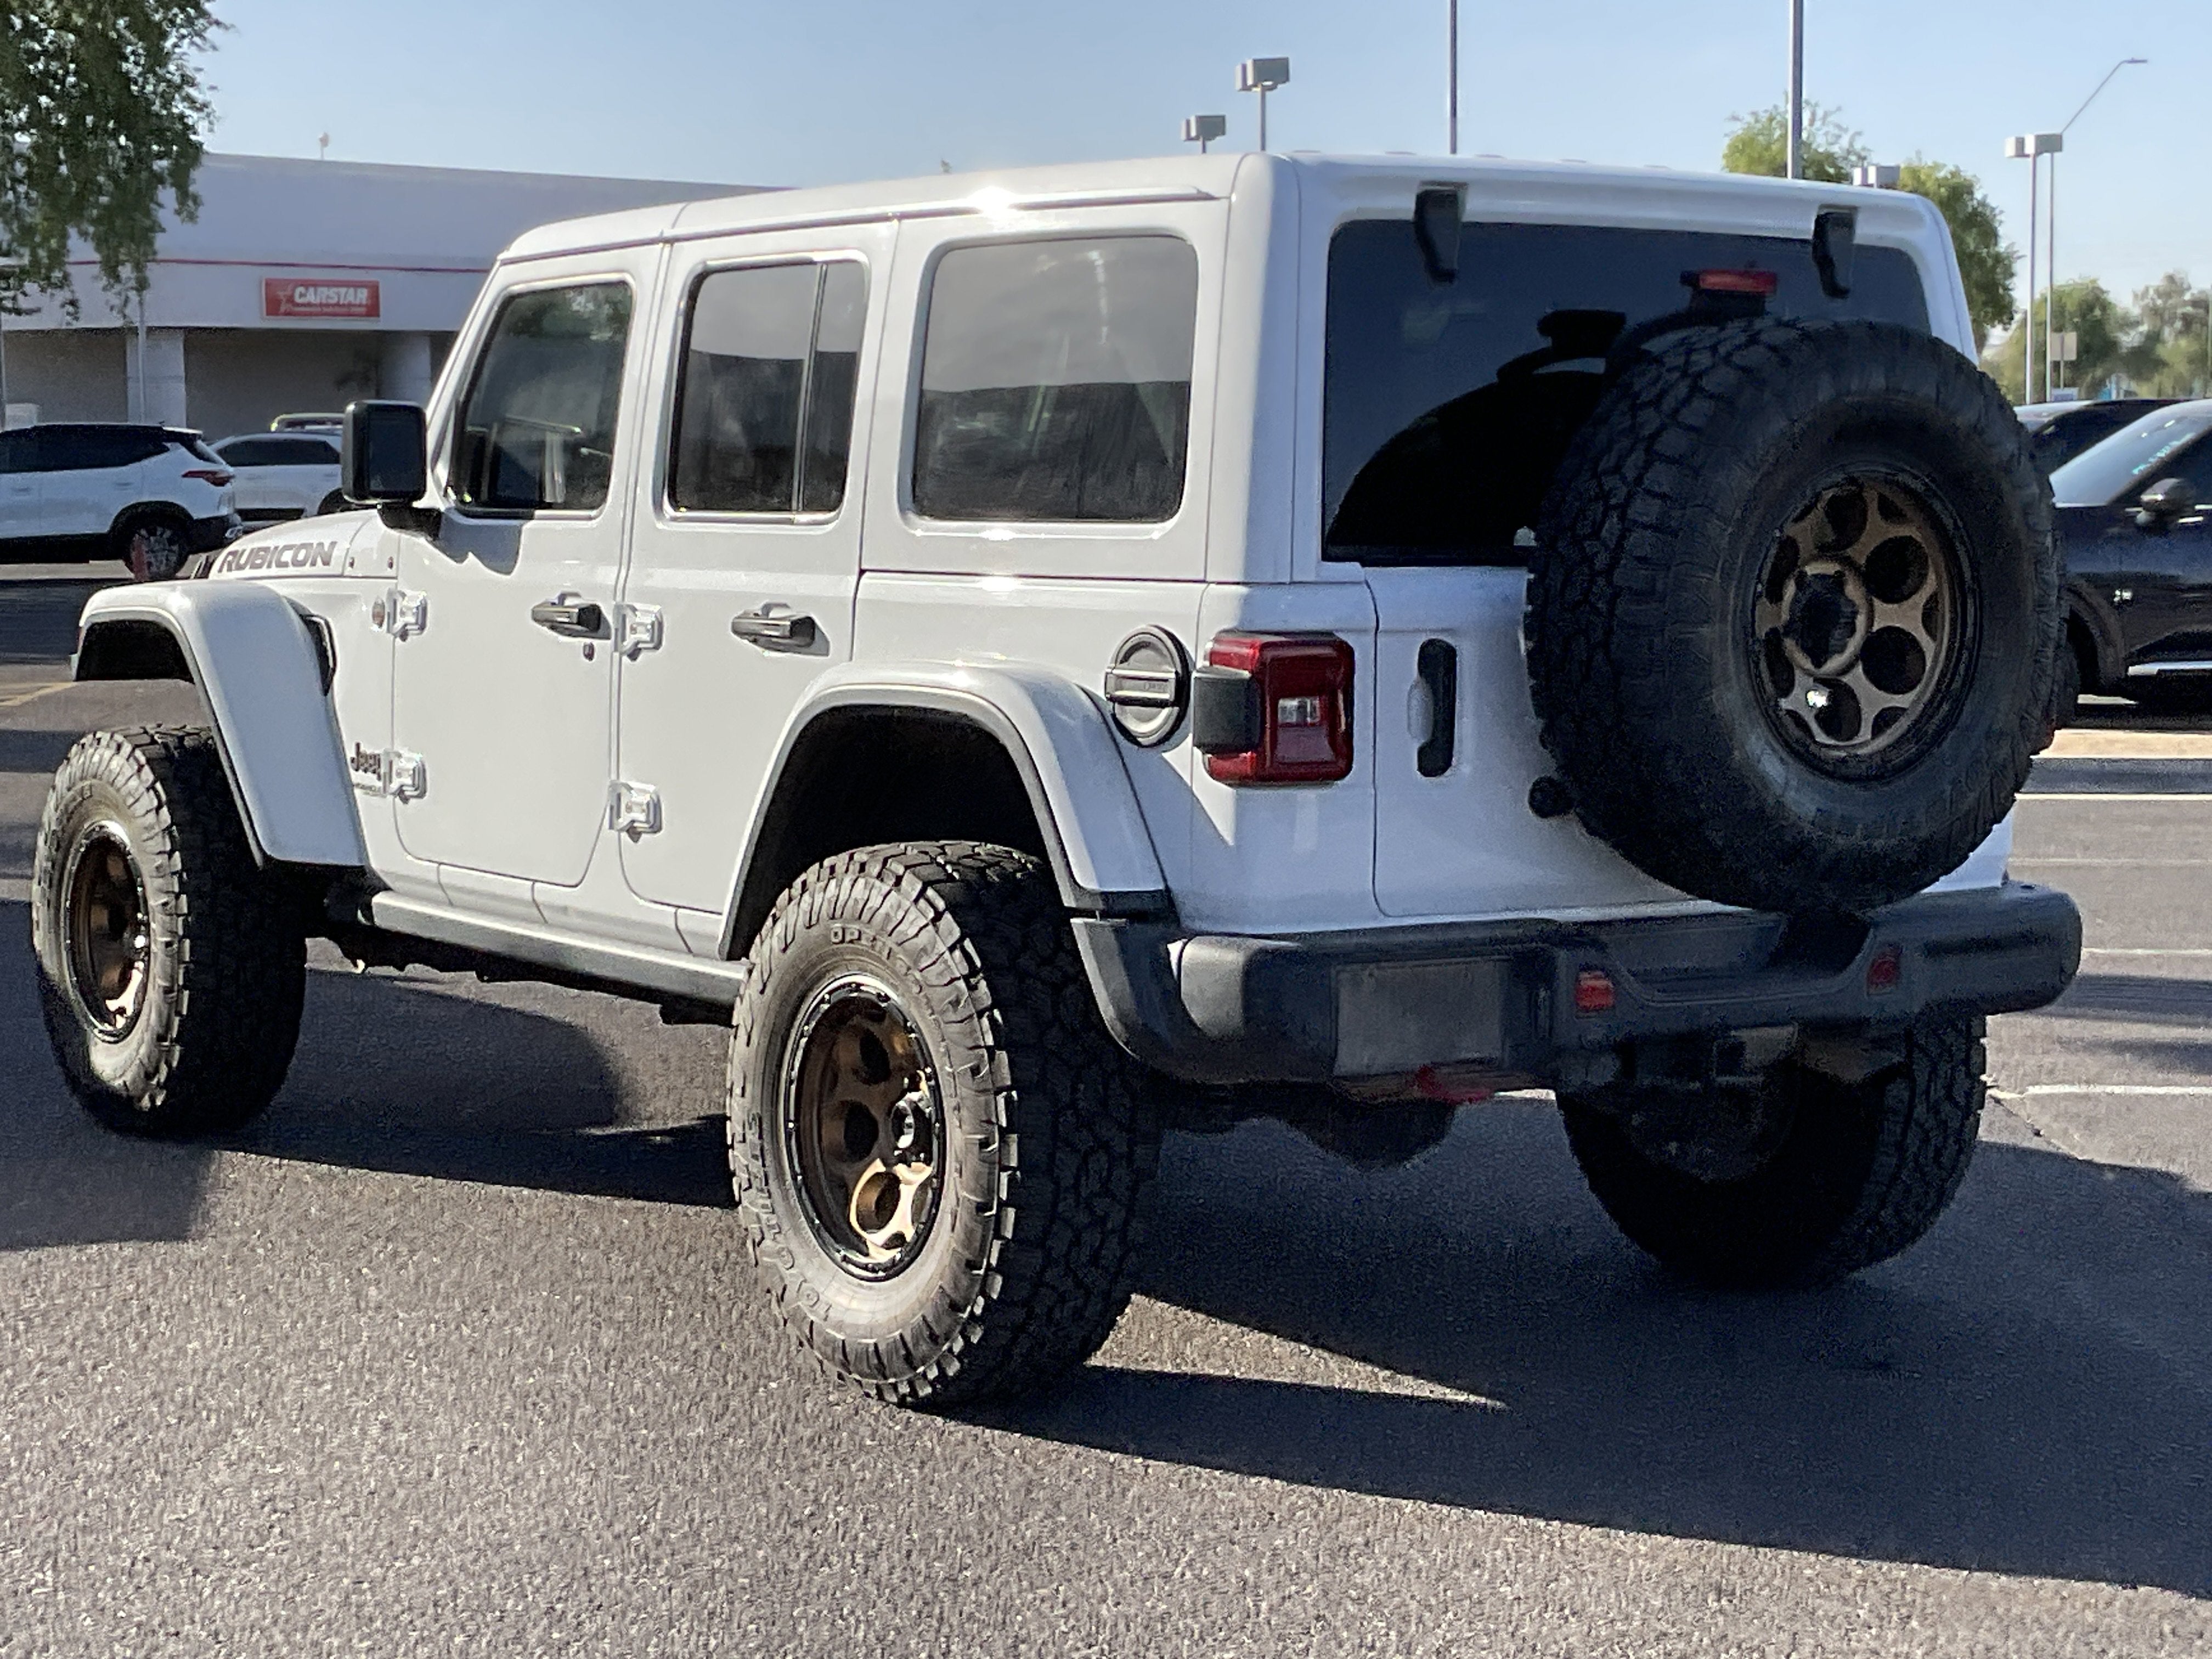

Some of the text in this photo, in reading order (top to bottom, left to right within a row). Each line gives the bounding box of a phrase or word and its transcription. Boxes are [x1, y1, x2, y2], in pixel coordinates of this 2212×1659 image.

[294, 286, 368, 304] CARSTAR
[217, 541, 338, 573] RUBICON
[351, 742, 381, 781] Jeep
